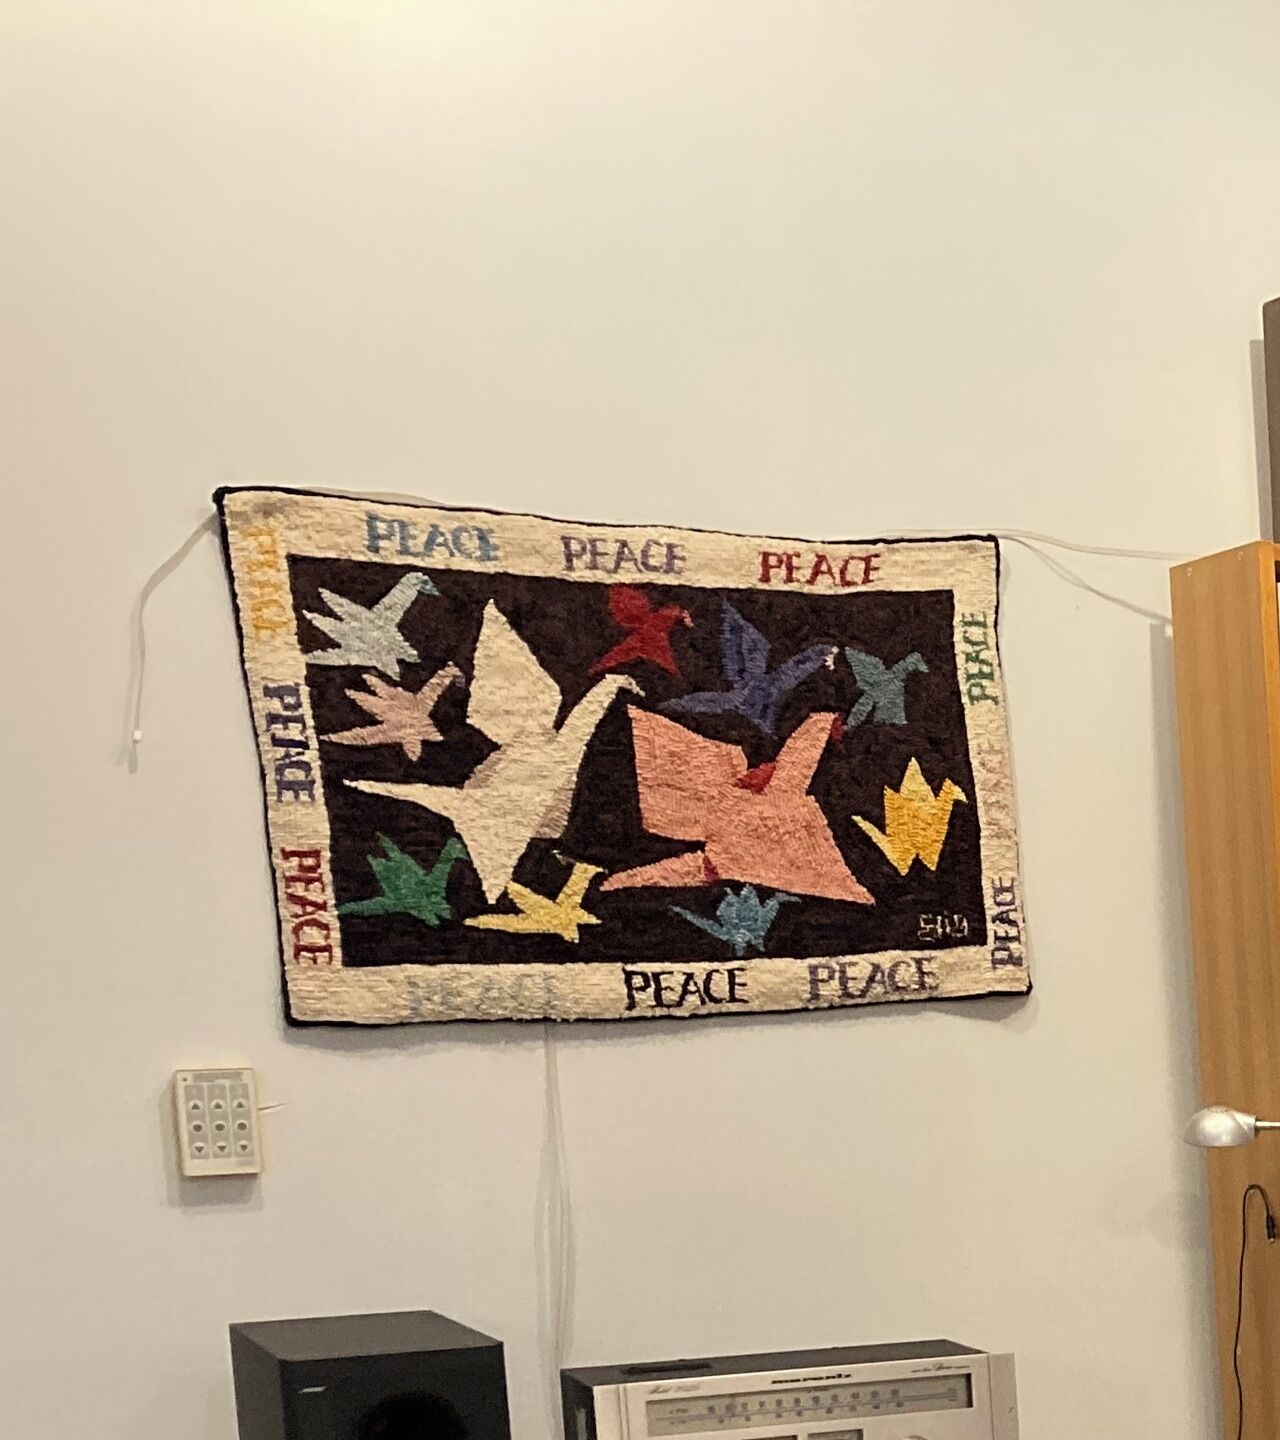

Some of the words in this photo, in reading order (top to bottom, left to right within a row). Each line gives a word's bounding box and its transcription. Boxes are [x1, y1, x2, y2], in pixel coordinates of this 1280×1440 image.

[366, 511, 500, 561] PEACE
[560, 535, 687, 575] PEACE
[758, 551, 881, 587] PEACE
[960, 611, 999, 706] PEACE
[262, 682, 316, 803] PEACE
[281, 847, 333, 965] PEACE
[992, 876, 1025, 970] PEACE
[622, 966, 748, 1012] PEACE
[805, 956, 940, 1002] PEACE
